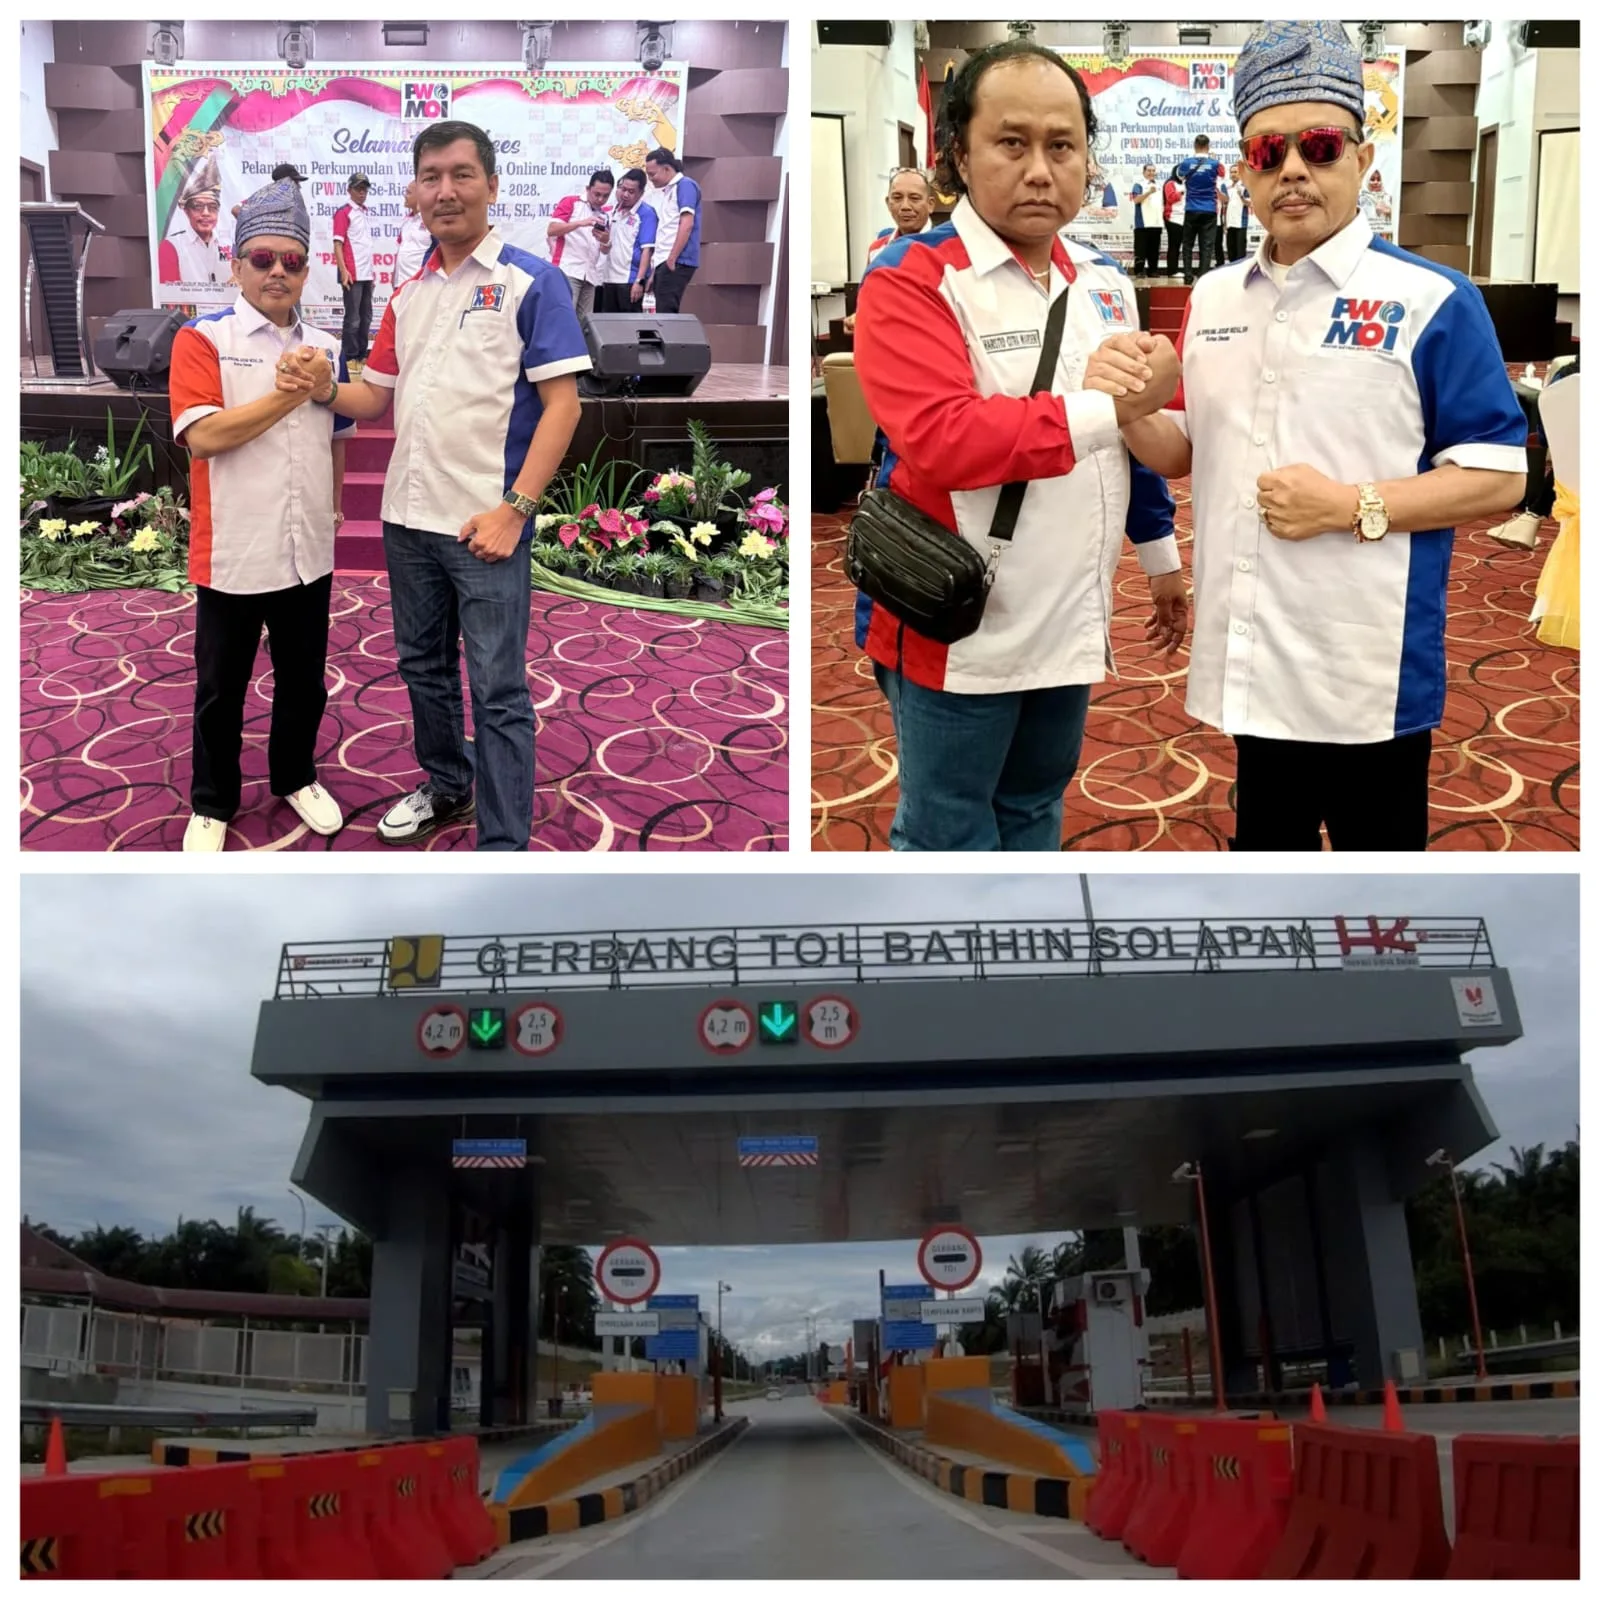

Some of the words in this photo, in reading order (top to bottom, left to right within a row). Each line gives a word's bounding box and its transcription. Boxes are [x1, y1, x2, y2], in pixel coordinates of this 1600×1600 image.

[1192, 76, 1225, 89] MOI
[405, 100, 448, 118] MOI
[1136, 97, 1205, 117] Selamat
[1208, 97, 1221, 116] &
[1120, 122, 1183, 135] Perkumpulan
[1120, 138, 1163, 151] (PWMOI)
[1124, 154, 1152, 167] Bapak
[312, 161, 393, 177] Perkumpulan
[506, 161, 547, 175] Online
[509, 183, 540, 196] 2028.
[514, 203, 536, 218] SE.,
[1323, 320, 1400, 351] MOI
[1334, 915, 1417, 956] HK
[476, 934, 739, 976] GERBANG
[758, 931, 863, 968] TOL
[882, 926, 1077, 965] BATHIN
[1093, 924, 1318, 961] SOLAPAN
[527, 1013, 546, 1029] 2,5
[820, 1006, 840, 1023] 2,5
[425, 1024, 444, 1041] 4,2
[449, 1026, 460, 1040] m
[707, 1019, 728, 1035] 4,2
[734, 1020, 746, 1033] m
[825, 1026, 837, 1039] m
[530, 1033, 542, 1045] m
